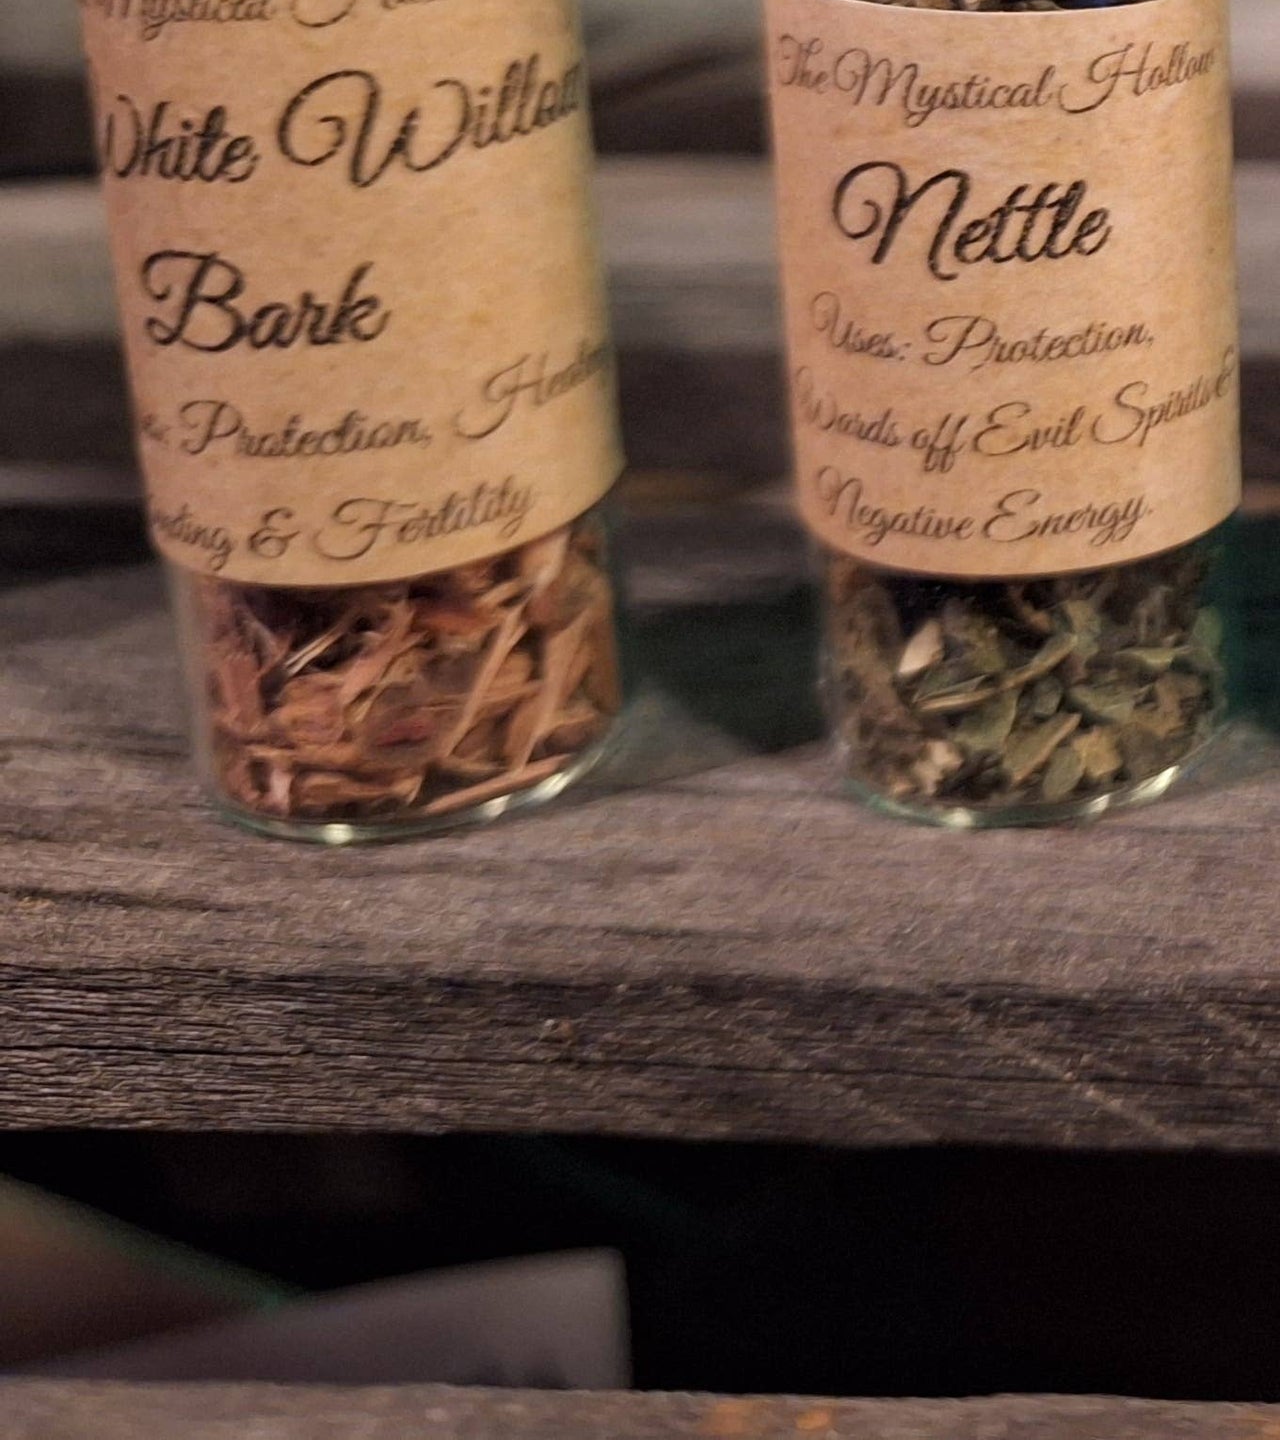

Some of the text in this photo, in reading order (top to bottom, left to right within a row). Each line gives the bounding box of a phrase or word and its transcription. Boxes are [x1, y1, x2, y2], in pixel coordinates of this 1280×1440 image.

[779, 33, 1212, 127] The Mystical Hollow
[832, 161, 1113, 281] Nettle
[140, 249, 391, 351] Bark
[811, 291, 1155, 372] Uses: Protection,
[796, 366, 902, 447] Wards
[911, 412, 970, 473] off
[972, 402, 1086, 456] Evil
[1091, 380, 1211, 448] Spirits
[248, 507, 300, 558] &
[313, 474, 535, 559] Fertility
[818, 465, 975, 546] Negative
